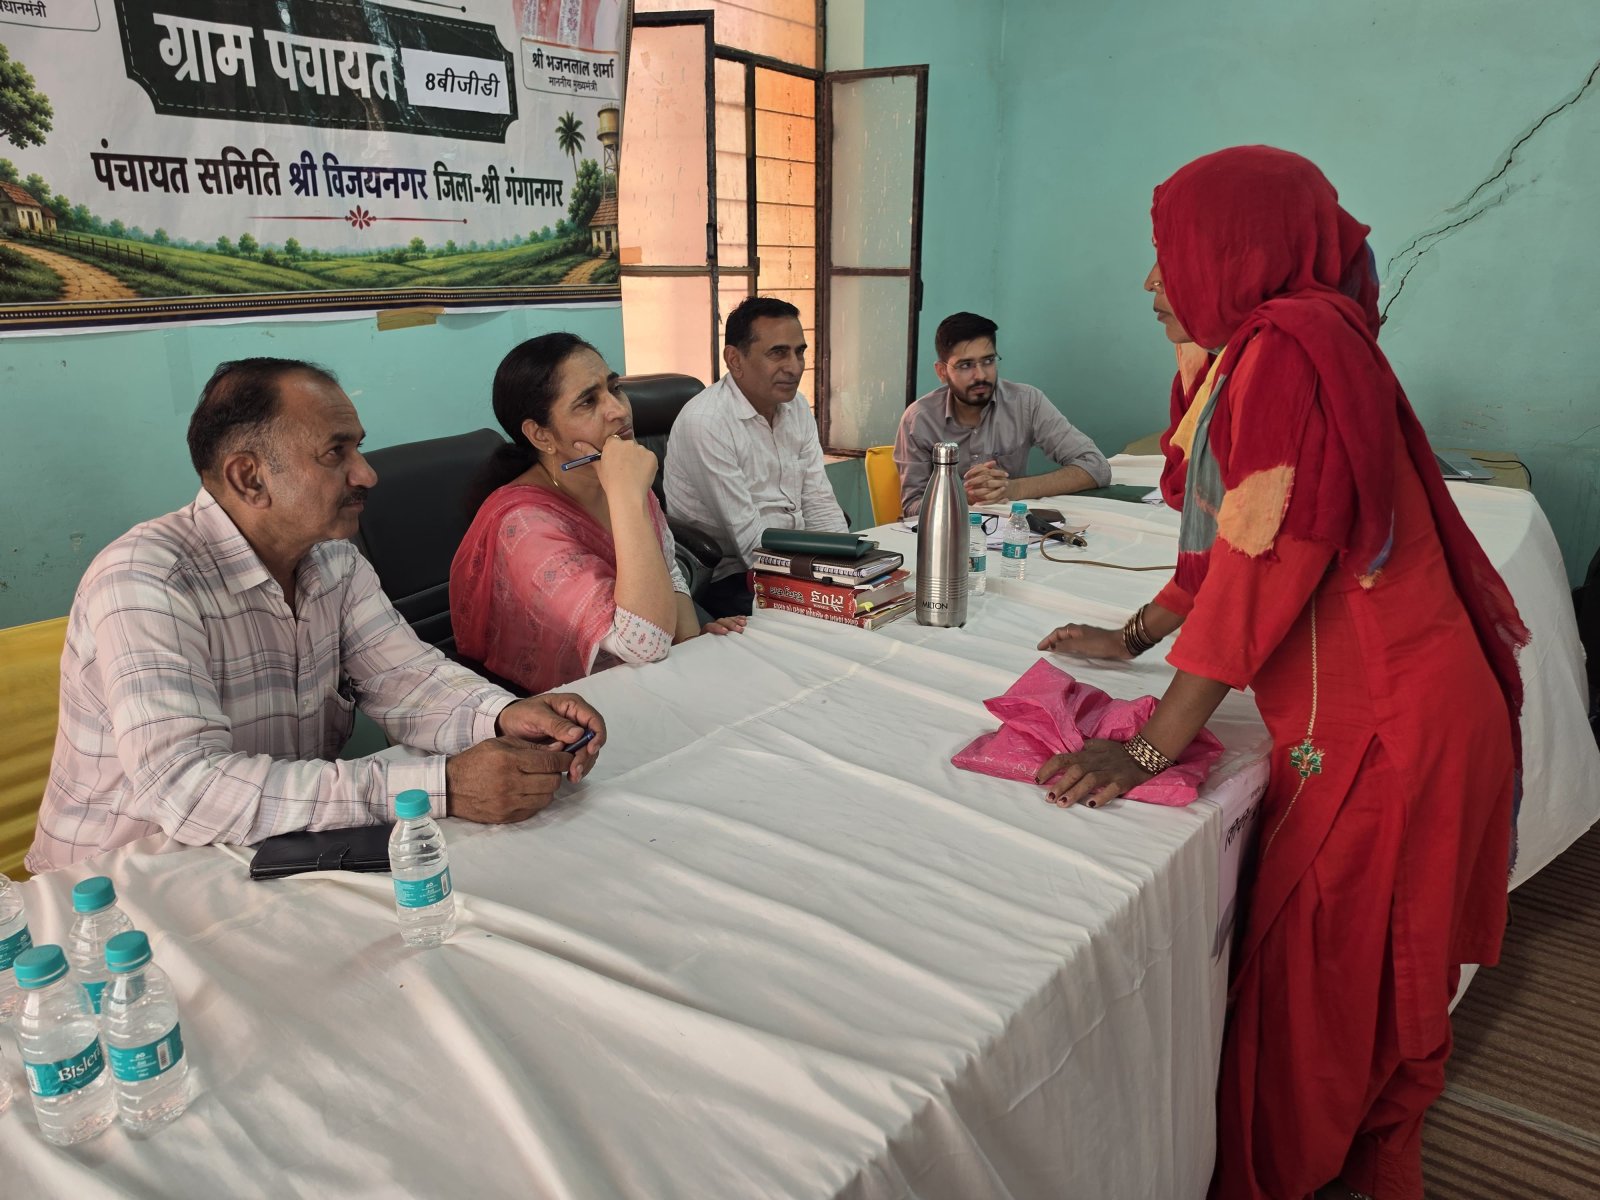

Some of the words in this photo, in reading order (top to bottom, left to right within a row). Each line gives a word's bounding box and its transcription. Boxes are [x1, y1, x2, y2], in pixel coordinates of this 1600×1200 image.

[153, 12, 256, 87] ग्राम
[263, 8, 398, 101] पंचायत
[425, 67, 501, 98] 8बीजीडी
[532, 48, 544, 69] श्री
[546, 55, 590, 77] भजनलाल
[593, 58, 614, 79] शर्मा
[548, 76, 572, 88] माननीय
[90, 138, 190, 194] पंचायत
[194, 145, 282, 196] समिति
[289, 150, 319, 197] श्री
[322, 152, 428, 200] विजयनगर
[504, 166, 564, 207] गंगानगर
[921, 600, 948, 610] MILTON
